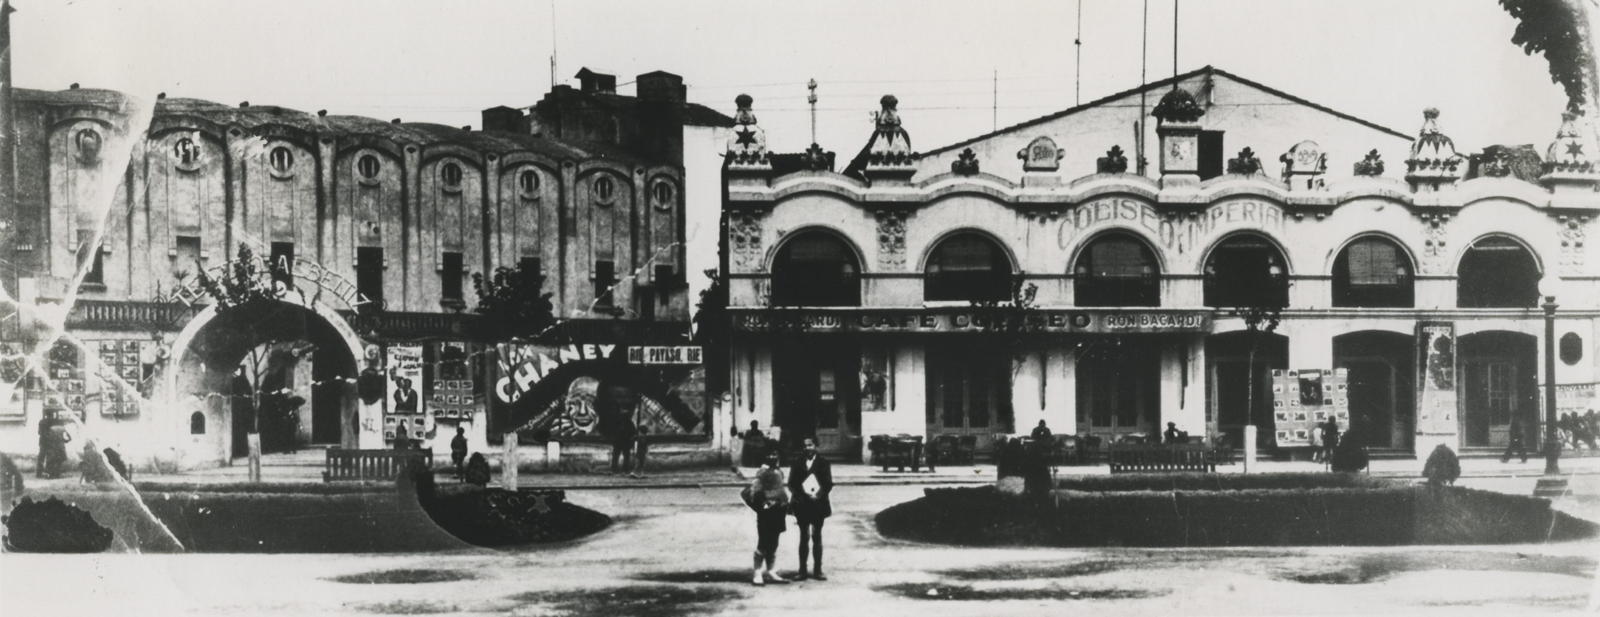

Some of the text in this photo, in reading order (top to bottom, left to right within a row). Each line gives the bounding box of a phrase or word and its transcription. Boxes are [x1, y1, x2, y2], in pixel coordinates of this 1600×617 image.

[1106, 314, 1202, 328] RON BACARDI
[496, 344, 616, 403] CHANEY
